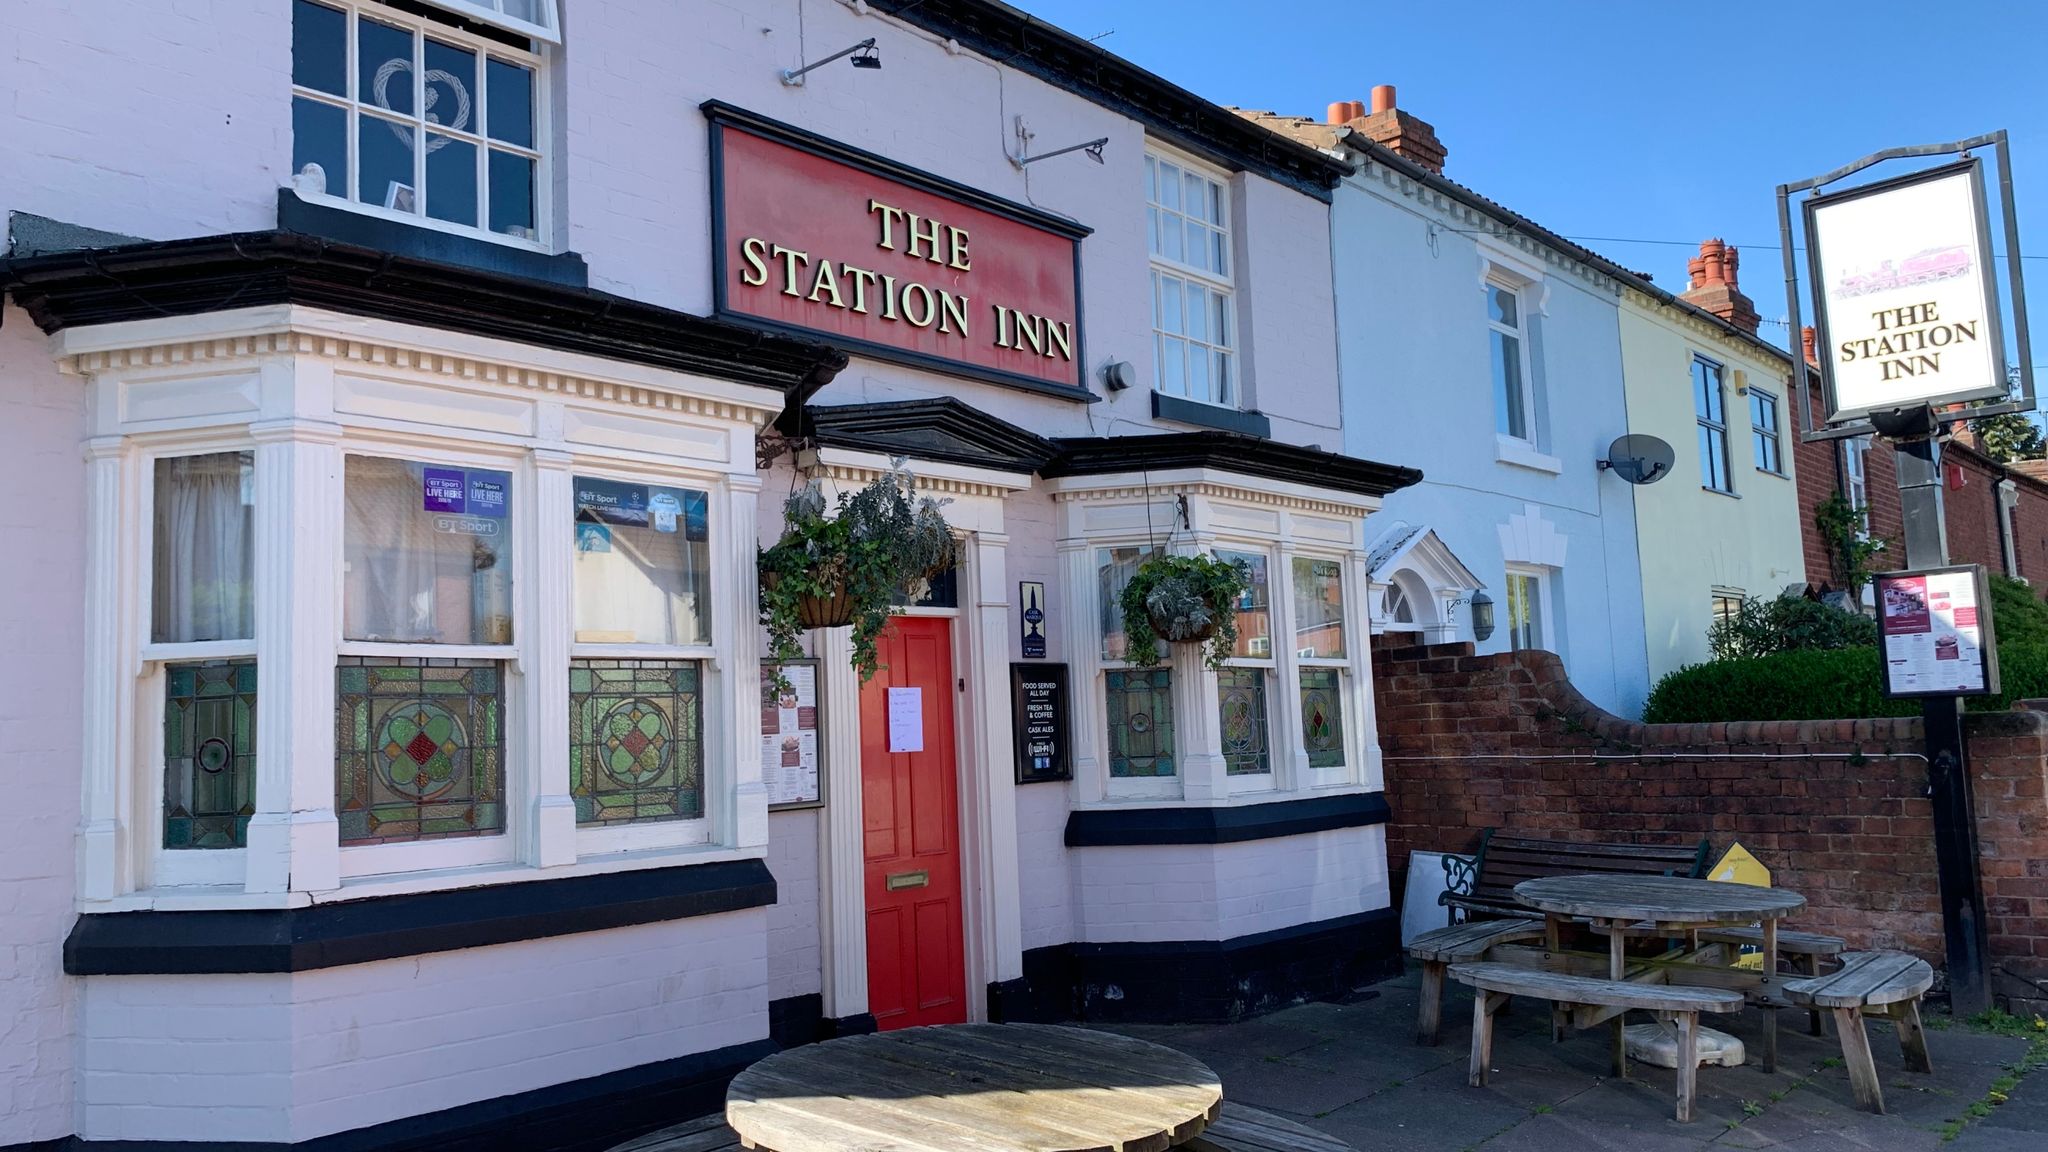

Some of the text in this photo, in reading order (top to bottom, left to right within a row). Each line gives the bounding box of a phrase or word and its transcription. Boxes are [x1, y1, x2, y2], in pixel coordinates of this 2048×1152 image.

[868, 199, 971, 272] THE
[740, 237, 1071, 361] STATION INN
[1872, 301, 1939, 331] THE
[1840, 320, 1978, 362] STATION
[1880, 352, 1941, 381] INN
[441, 480, 459, 488] Sport
[426, 488, 463, 499] LIVE HERE
[471, 488, 504, 503] LIVE HERE
[596, 494, 618, 503] Sport
[439, 519, 492, 533] BT Sport
[1034, 711, 1053, 719] COFFEE
[1027, 725, 1054, 734] CASK ALES
